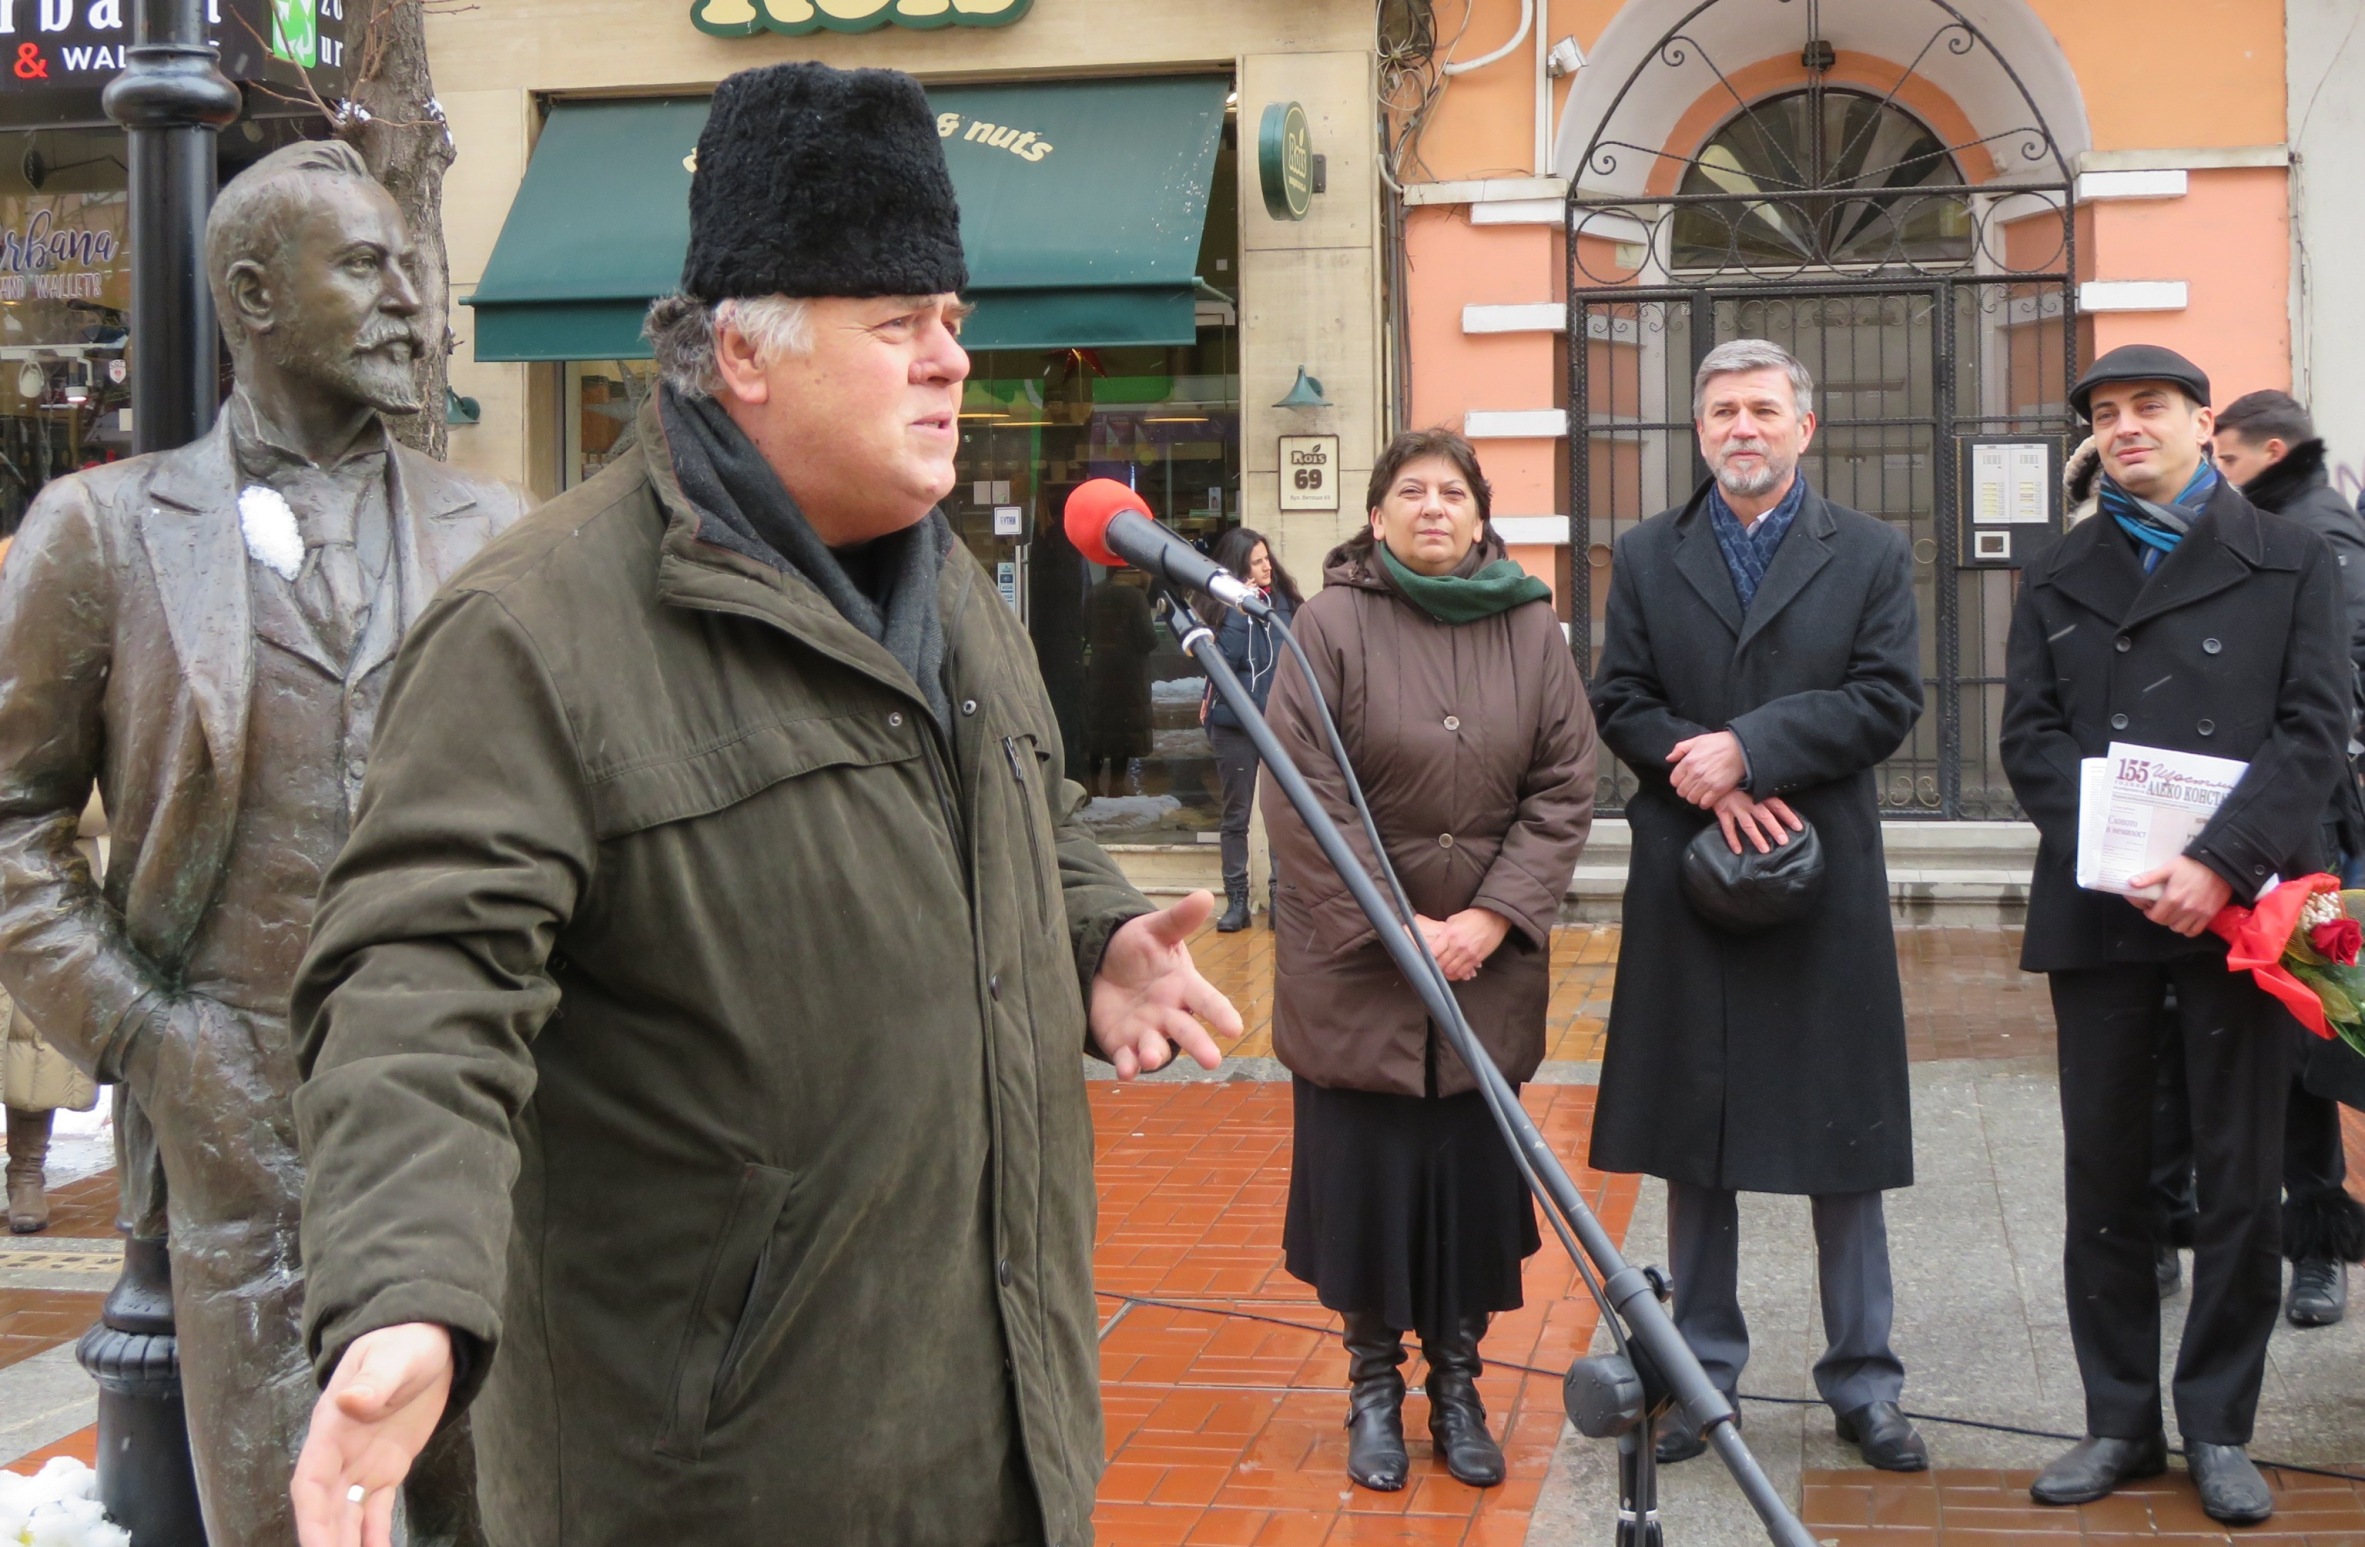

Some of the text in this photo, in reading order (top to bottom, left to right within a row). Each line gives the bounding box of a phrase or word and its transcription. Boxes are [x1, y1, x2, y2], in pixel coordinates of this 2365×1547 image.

[13, 42, 48, 79] &
[320, 35, 344, 67] ur
[963, 120, 1053, 162] nuts
[0, 209, 119, 272] rbana
[0, 272, 102, 300] AND WALLETS
[1291, 450, 1327, 465] Rois
[1294, 468, 1323, 490] 69
[2116, 758, 2150, 783] 155
[2146, 780, 2182, 800] АЛЕКО
